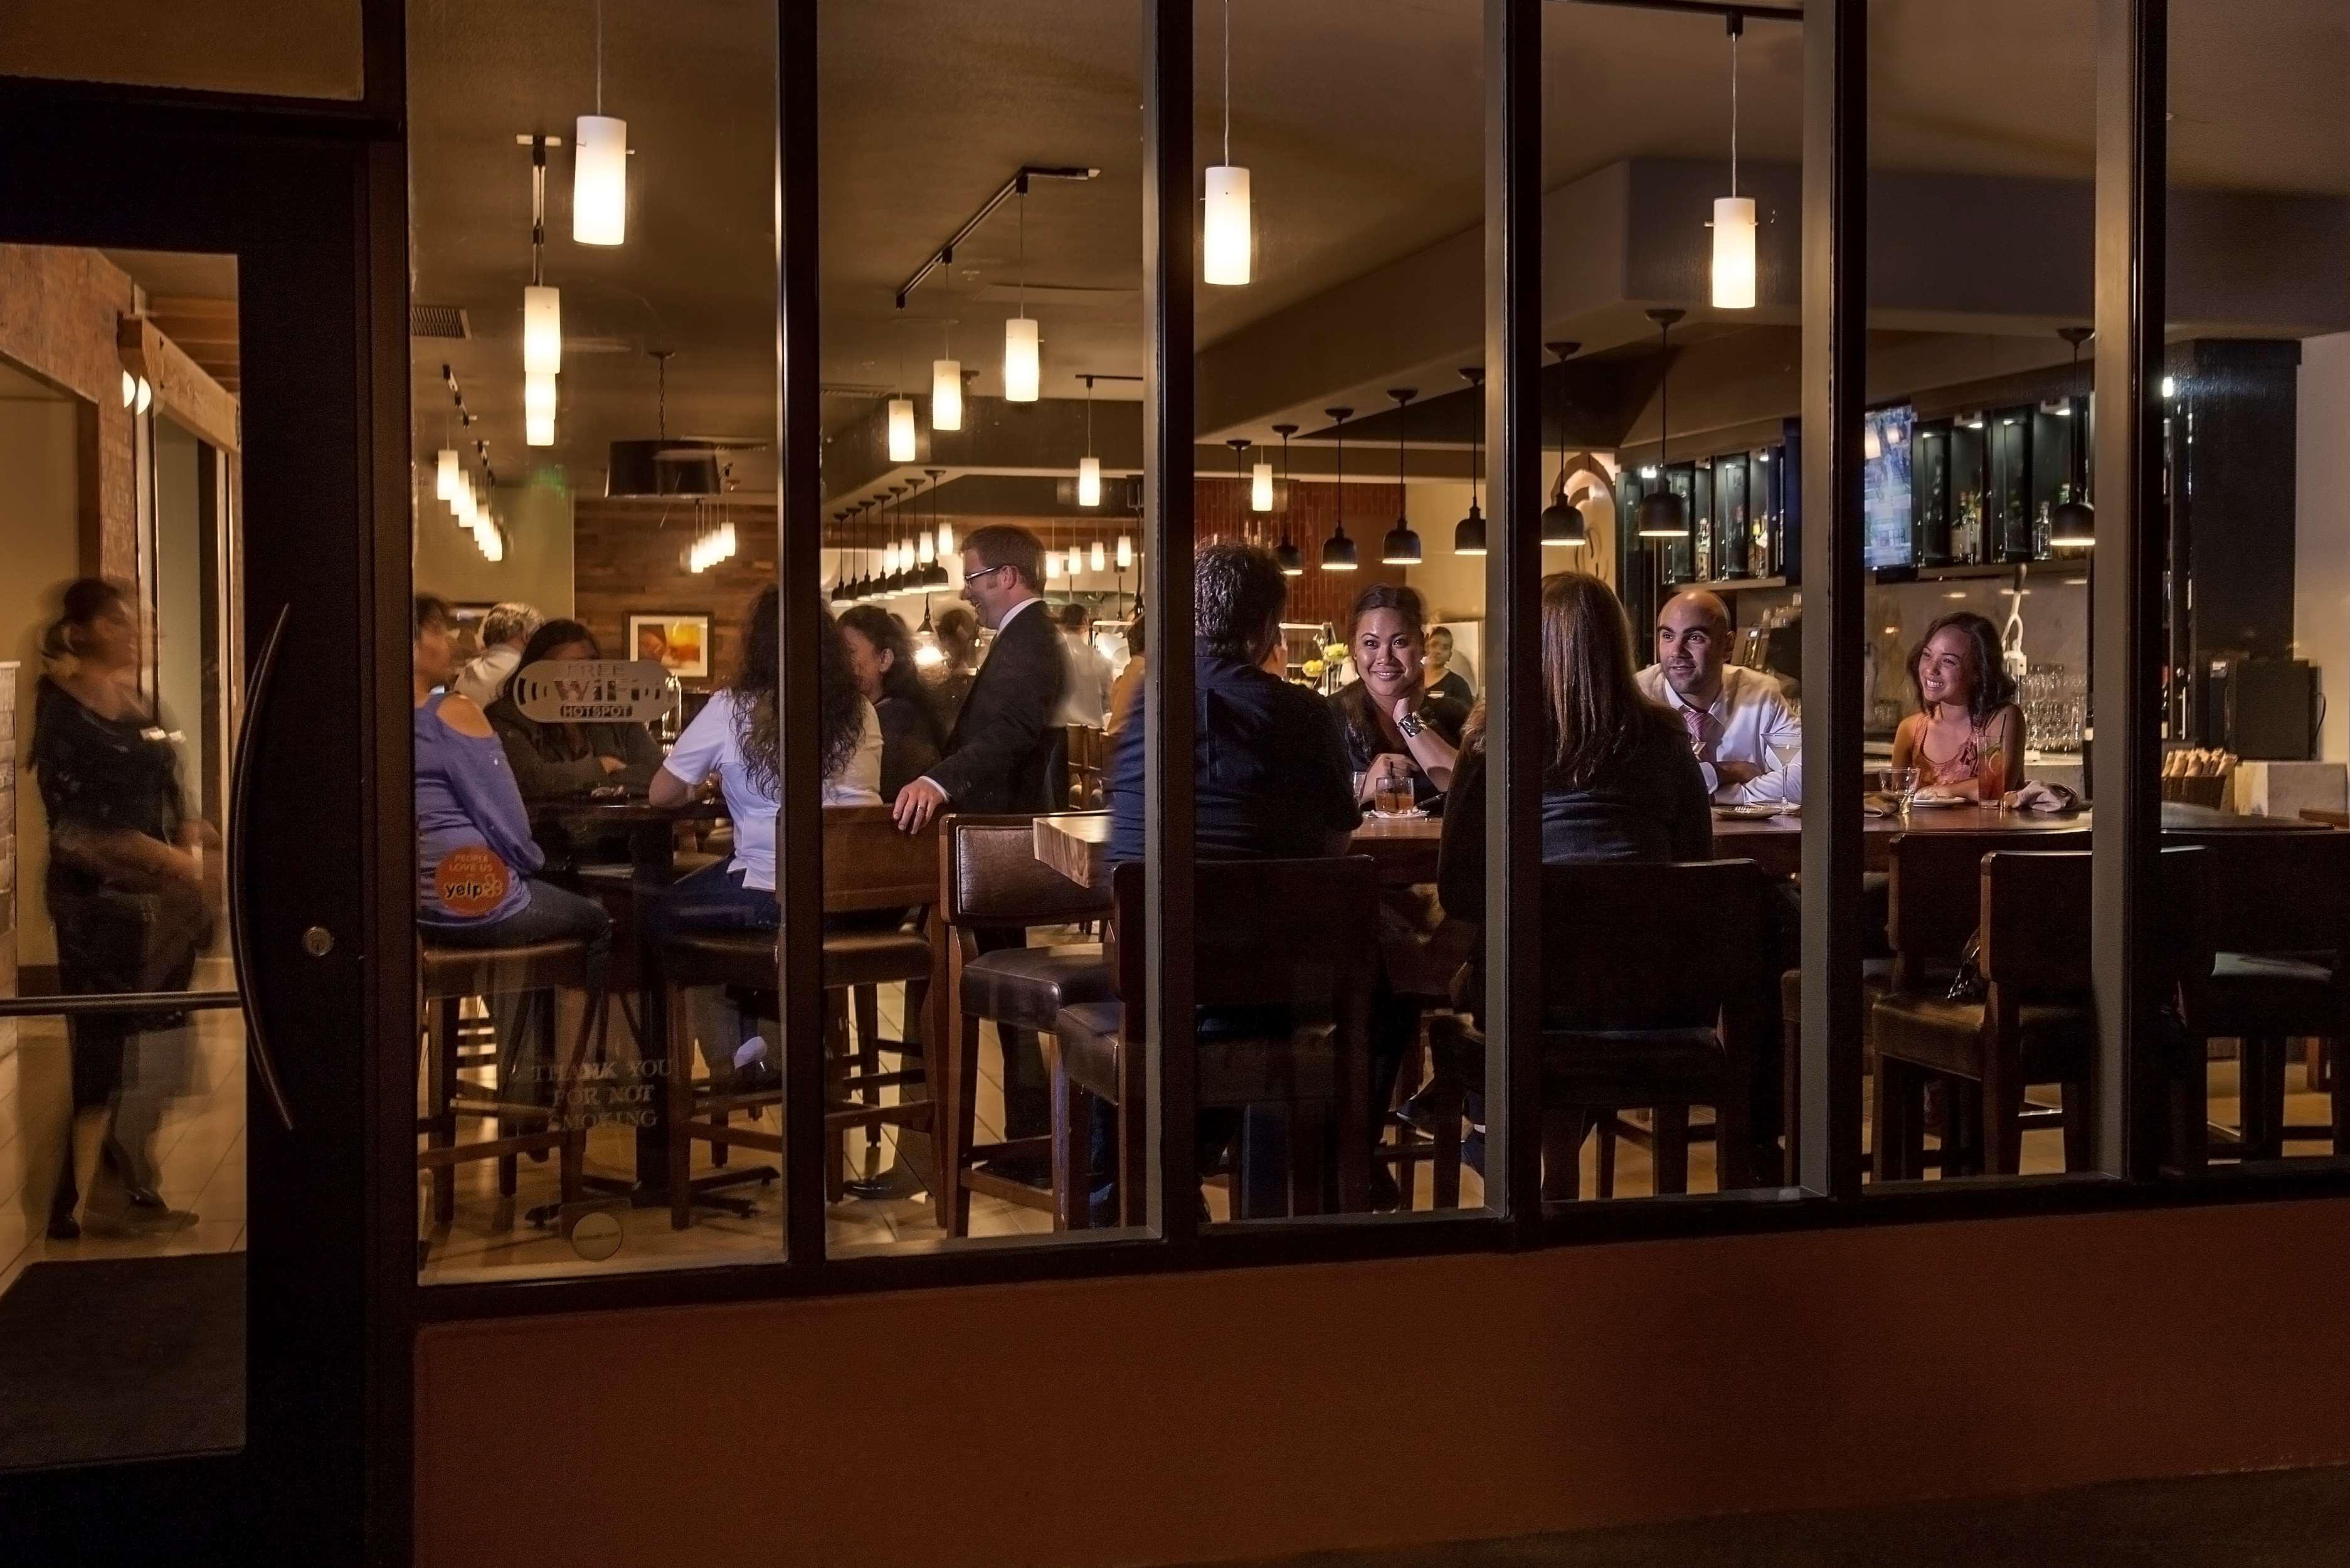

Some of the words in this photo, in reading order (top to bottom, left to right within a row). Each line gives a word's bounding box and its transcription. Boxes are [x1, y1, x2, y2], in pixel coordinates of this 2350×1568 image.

[568, 665, 625, 676] FREE
[562, 706, 629, 718] HOTSPOT
[445, 881, 483, 899] yelp
[630, 1058, 673, 1078] YOU
[553, 1086, 599, 1107] FOR
[607, 1084, 656, 1104] NOT
